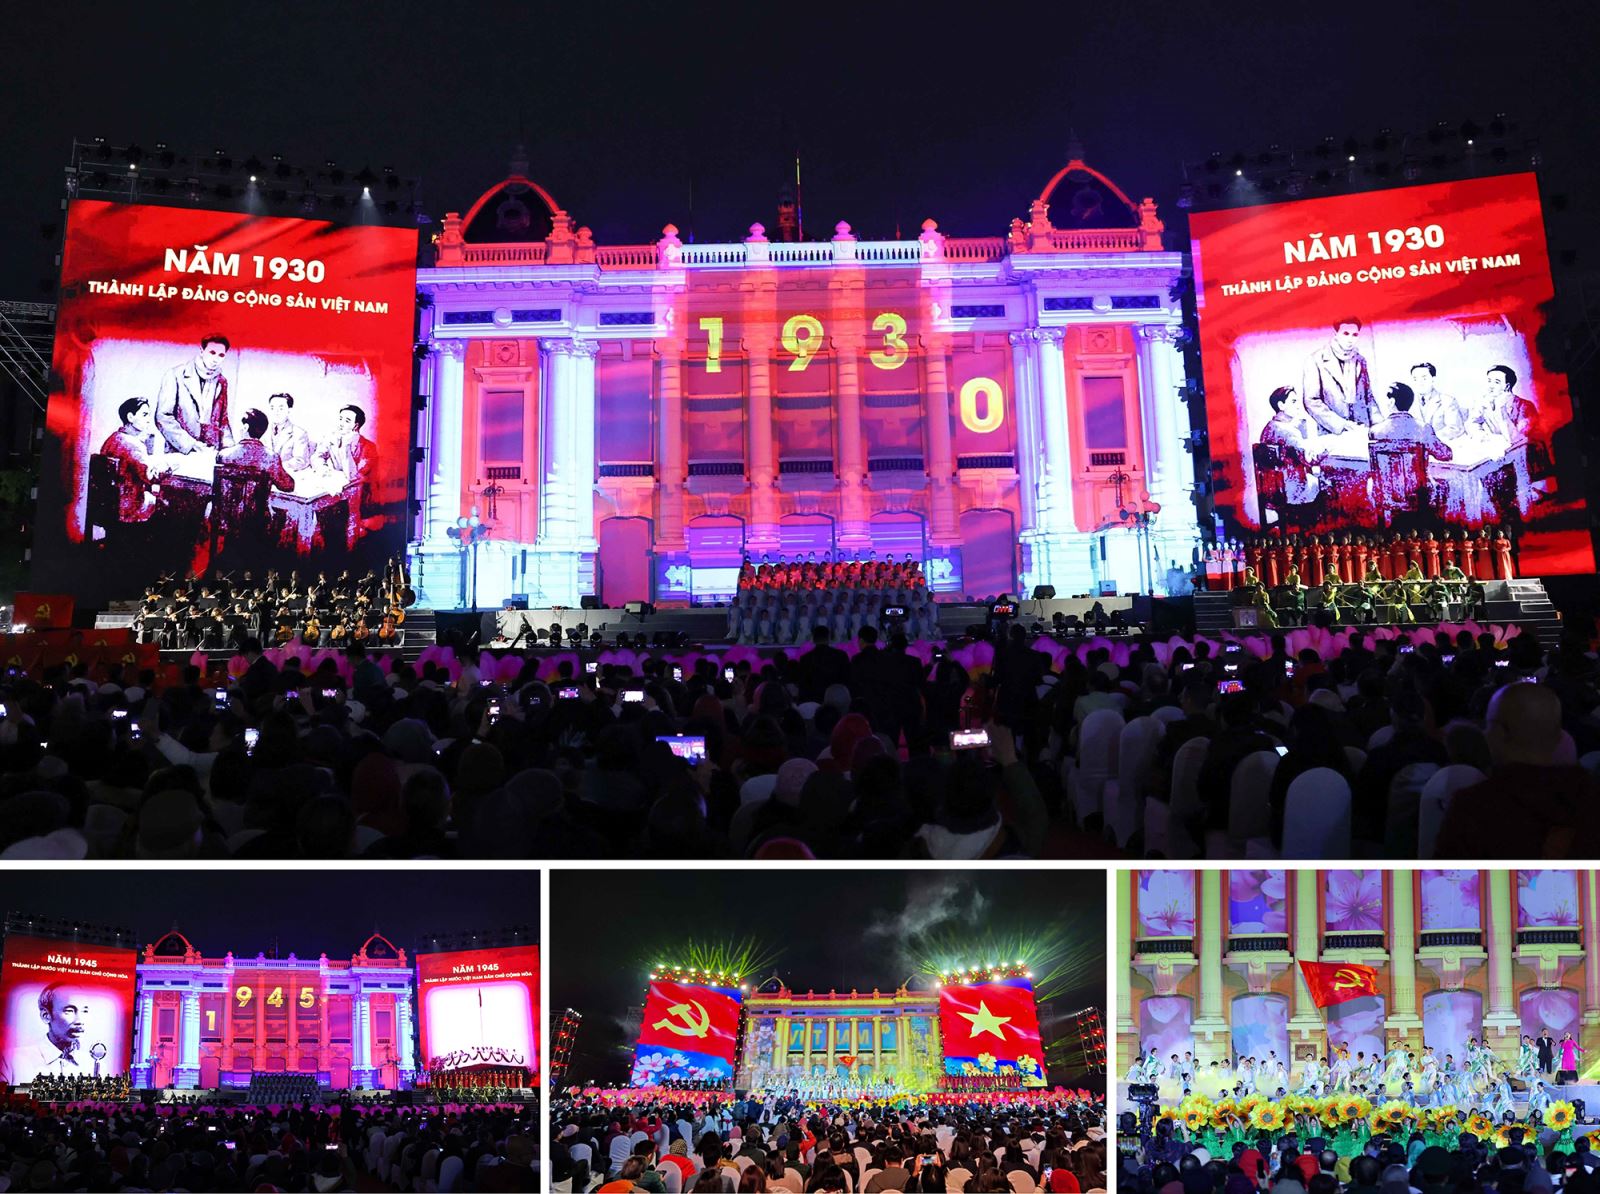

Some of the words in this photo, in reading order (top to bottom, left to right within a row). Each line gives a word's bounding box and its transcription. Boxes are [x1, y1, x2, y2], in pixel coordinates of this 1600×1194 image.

[1284, 232, 1357, 264] NĂM
[1368, 225, 1444, 254] 1930
[164, 245, 240, 276] NĂM
[253, 256, 324, 283] 1930
[1221, 280, 1272, 296] THÀNH
[1276, 276, 1303, 293] LẬP
[1306, 271, 1352, 287] ĐẢNG
[1357, 266, 1405, 283] CỘNG
[1409, 260, 1441, 276] SẢN
[1445, 256, 1477, 274] VIỆT
[1482, 254, 1520, 268] NAM
[88, 279, 143, 296] THÀNH
[148, 283, 178, 301] LẬP
[182, 285, 229, 302] ĐẢNG
[234, 290, 282, 307] CỘNG
[286, 292, 316, 308] SẢN
[321, 296, 351, 313] VIỆT
[354, 301, 388, 313] NAM
[47, 954, 71, 965] NĂM
[75, 958, 97, 968] 1945
[452, 964, 474, 974] NĂM
[477, 963, 499, 972] 1945
